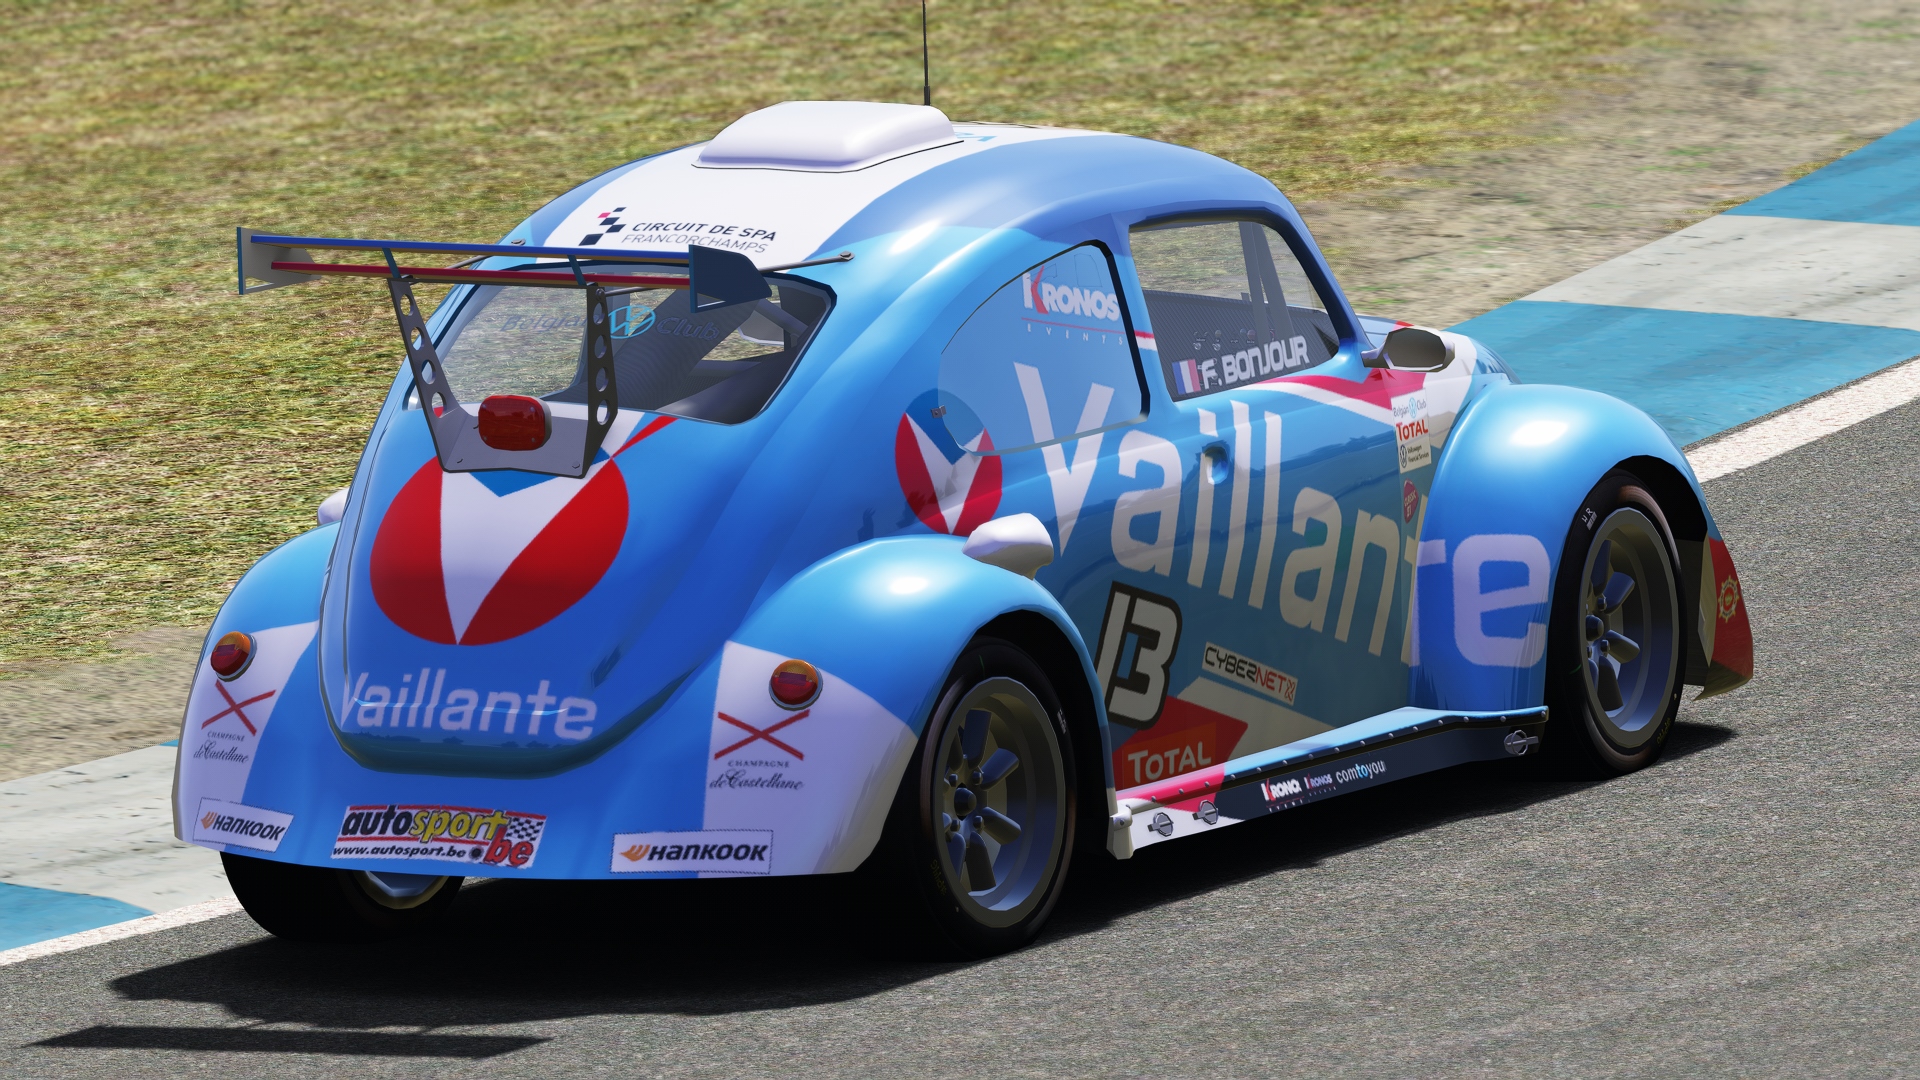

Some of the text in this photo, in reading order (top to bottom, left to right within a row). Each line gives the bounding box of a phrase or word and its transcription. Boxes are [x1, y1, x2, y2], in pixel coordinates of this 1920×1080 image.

[632, 222, 777, 241] CIRCUIT DE SPA
[621, 234, 769, 254] FRANCORCHAMPS
[1022, 265, 1121, 322] KRONOS
[500, 312, 588, 333] Belgia
[656, 316, 720, 341] Club
[1027, 322, 1124, 346] EVENTS
[1201, 335, 1310, 390] F. BONJOUR
[1396, 419, 1429, 442] TOTAL
[1013, 360, 1551, 669] Vaillante
[340, 667, 598, 741] Vaillante
[727, 760, 790, 768] CHAMPAGNE
[1128, 741, 1212, 784] TOTAL
[1335, 760, 1386, 784] comtoyou
[332, 844, 467, 859] www.autosport.be
